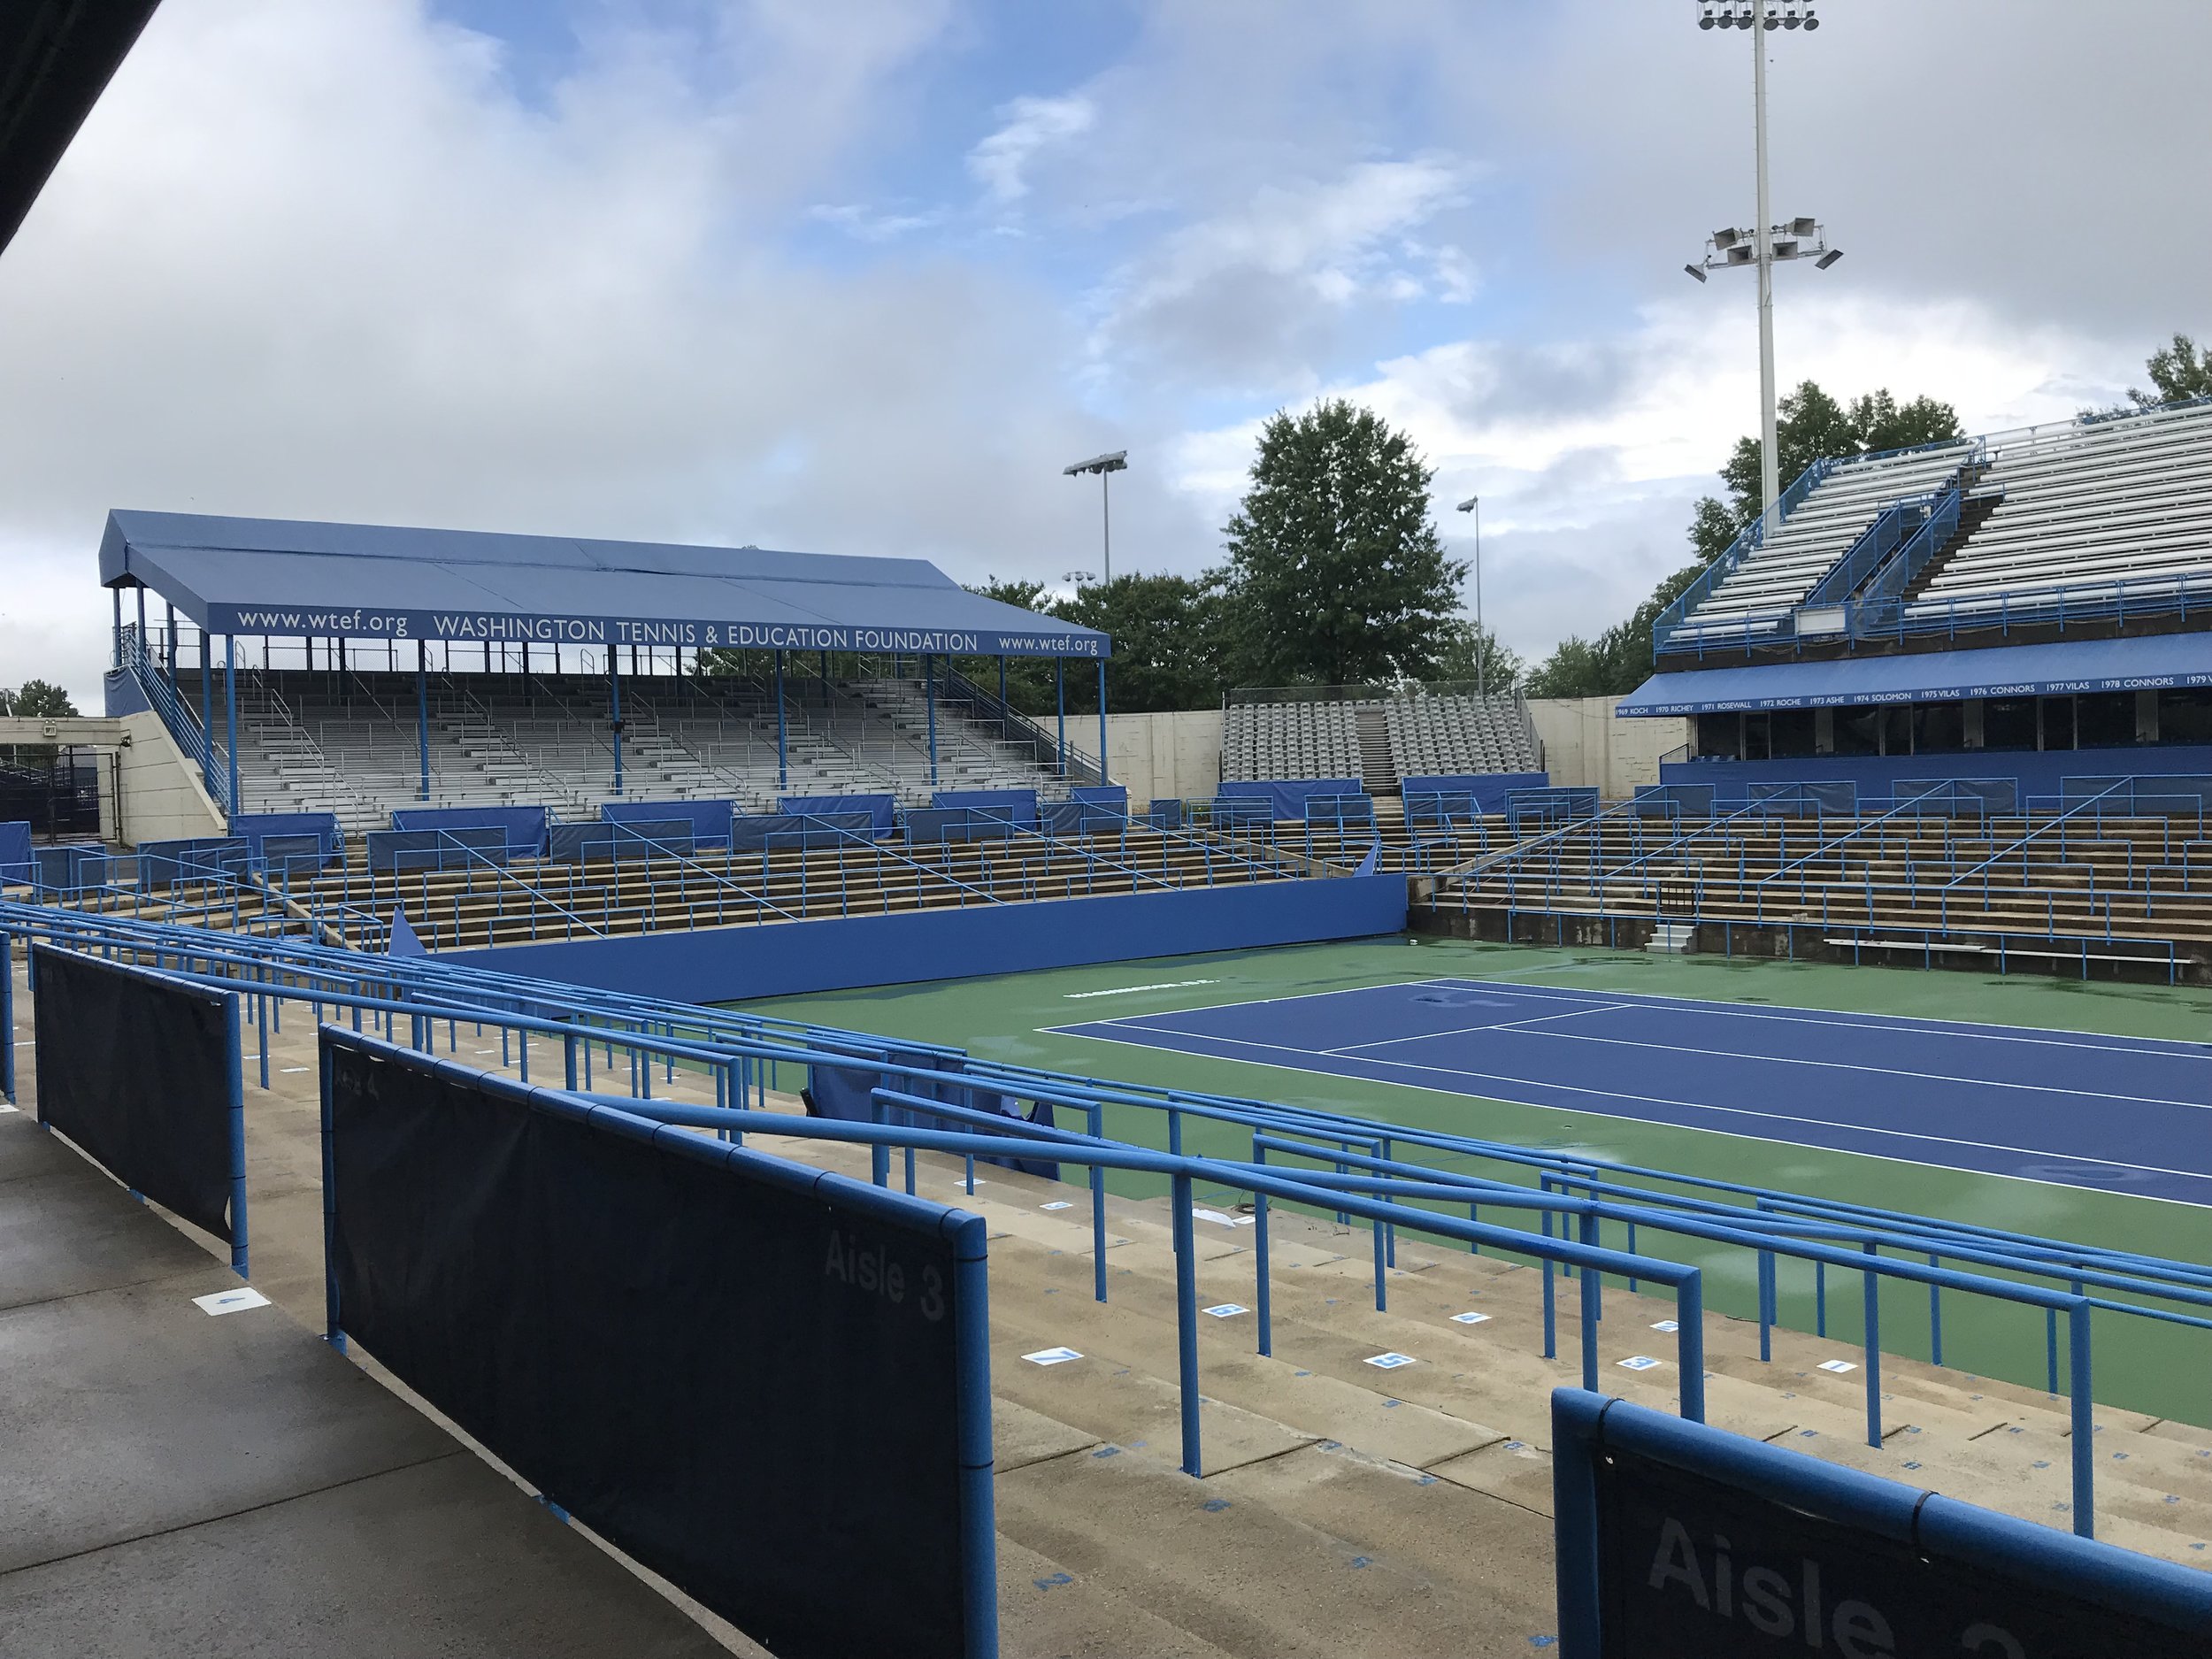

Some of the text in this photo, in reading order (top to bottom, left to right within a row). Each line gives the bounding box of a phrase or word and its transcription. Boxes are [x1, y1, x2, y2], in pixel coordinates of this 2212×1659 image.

[238, 610, 407, 637] www.wtef.org
[433, 614, 977, 651] WASHINGTON TENNIS & EDUCATION FOUNDATION
[998, 635, 1098, 656] www.wtef.org
[2101, 676, 2175, 689] 1978 CONNORS
[2186, 675, 2207, 685] 1979
[1970, 684, 2036, 696] 1976 CONNORS
[2046, 681, 2090, 692] 1977 VILAS
[1825, 695, 1845, 704] ASHE
[1871, 692, 1912, 702] SOLOMON
[1921, 689, 1961, 699] 1975 VILAS
[1717, 701, 1752, 710] ROSEWALL
[1776, 698, 1801, 707] ROCHE
[826, 1230, 945, 1322] Aisle 3
[1032, 1349, 1079, 1363] 7
[1649, 1517, 1895, 1659] Aisle
